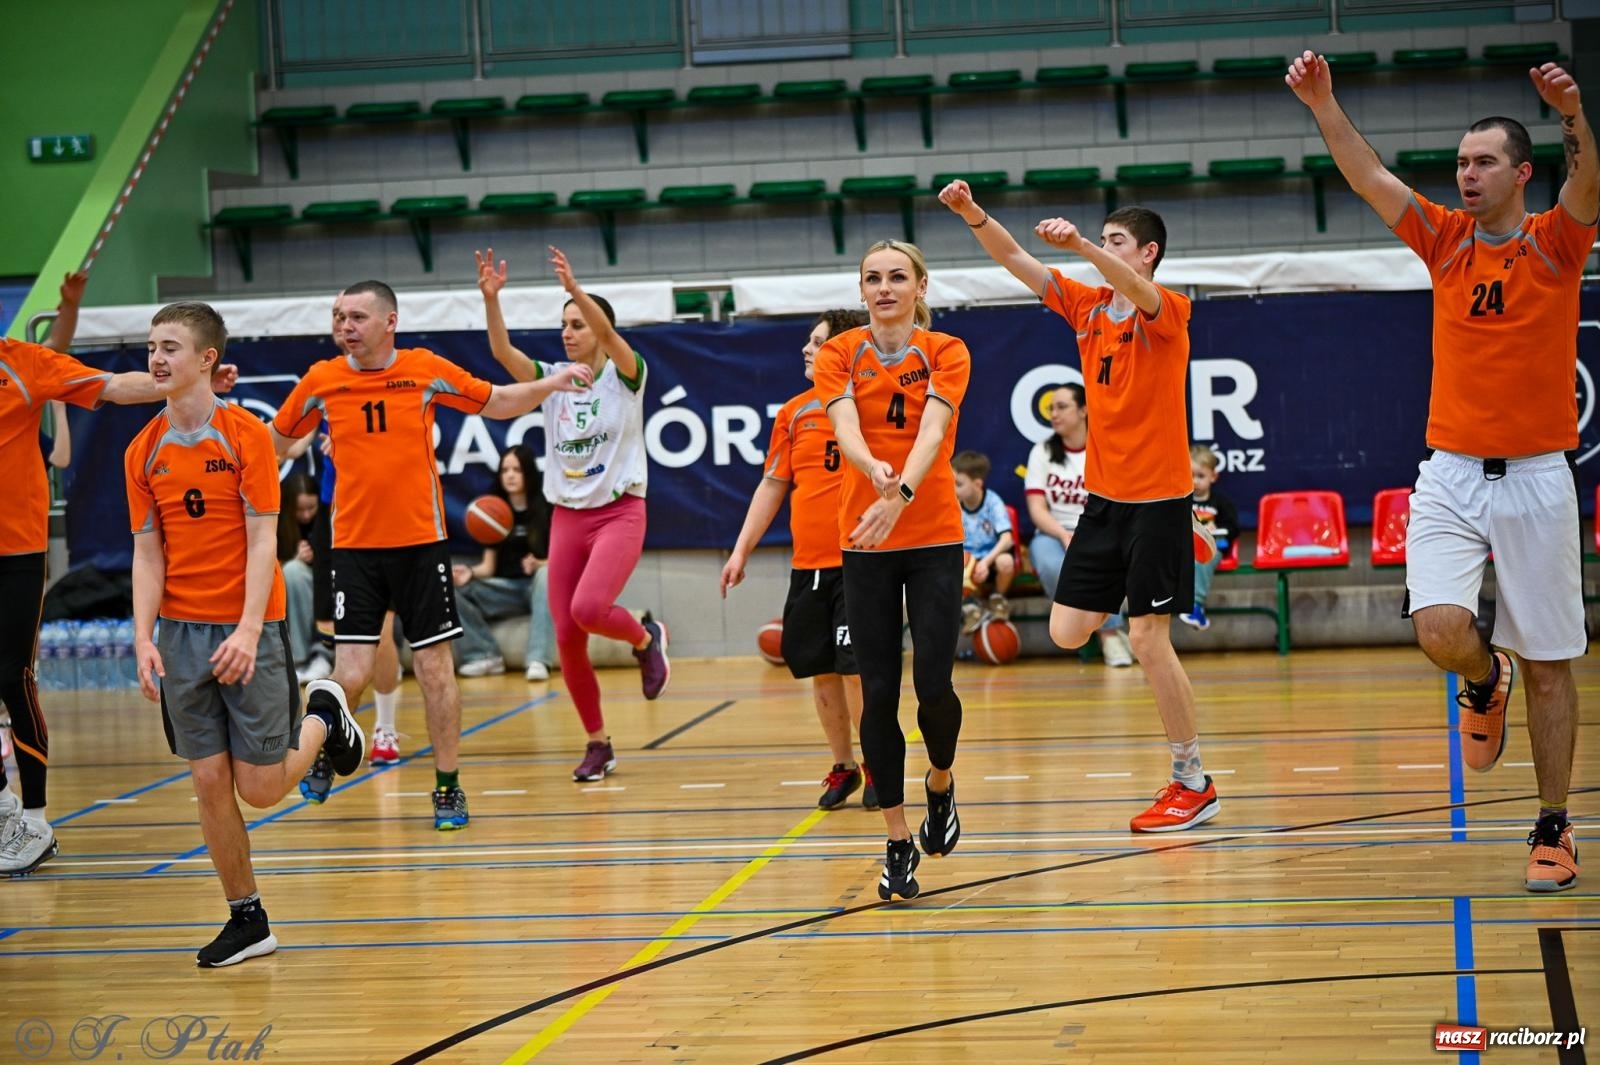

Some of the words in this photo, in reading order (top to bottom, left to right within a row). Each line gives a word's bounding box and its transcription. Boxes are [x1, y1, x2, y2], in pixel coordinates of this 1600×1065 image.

[1471, 279, 1504, 317] 24
[361, 400, 388, 433] 11
[576, 411, 587, 430] 5
[886, 392, 907, 430] 4
[824, 440, 841, 472] 5
[335, 591, 346, 621] 8
